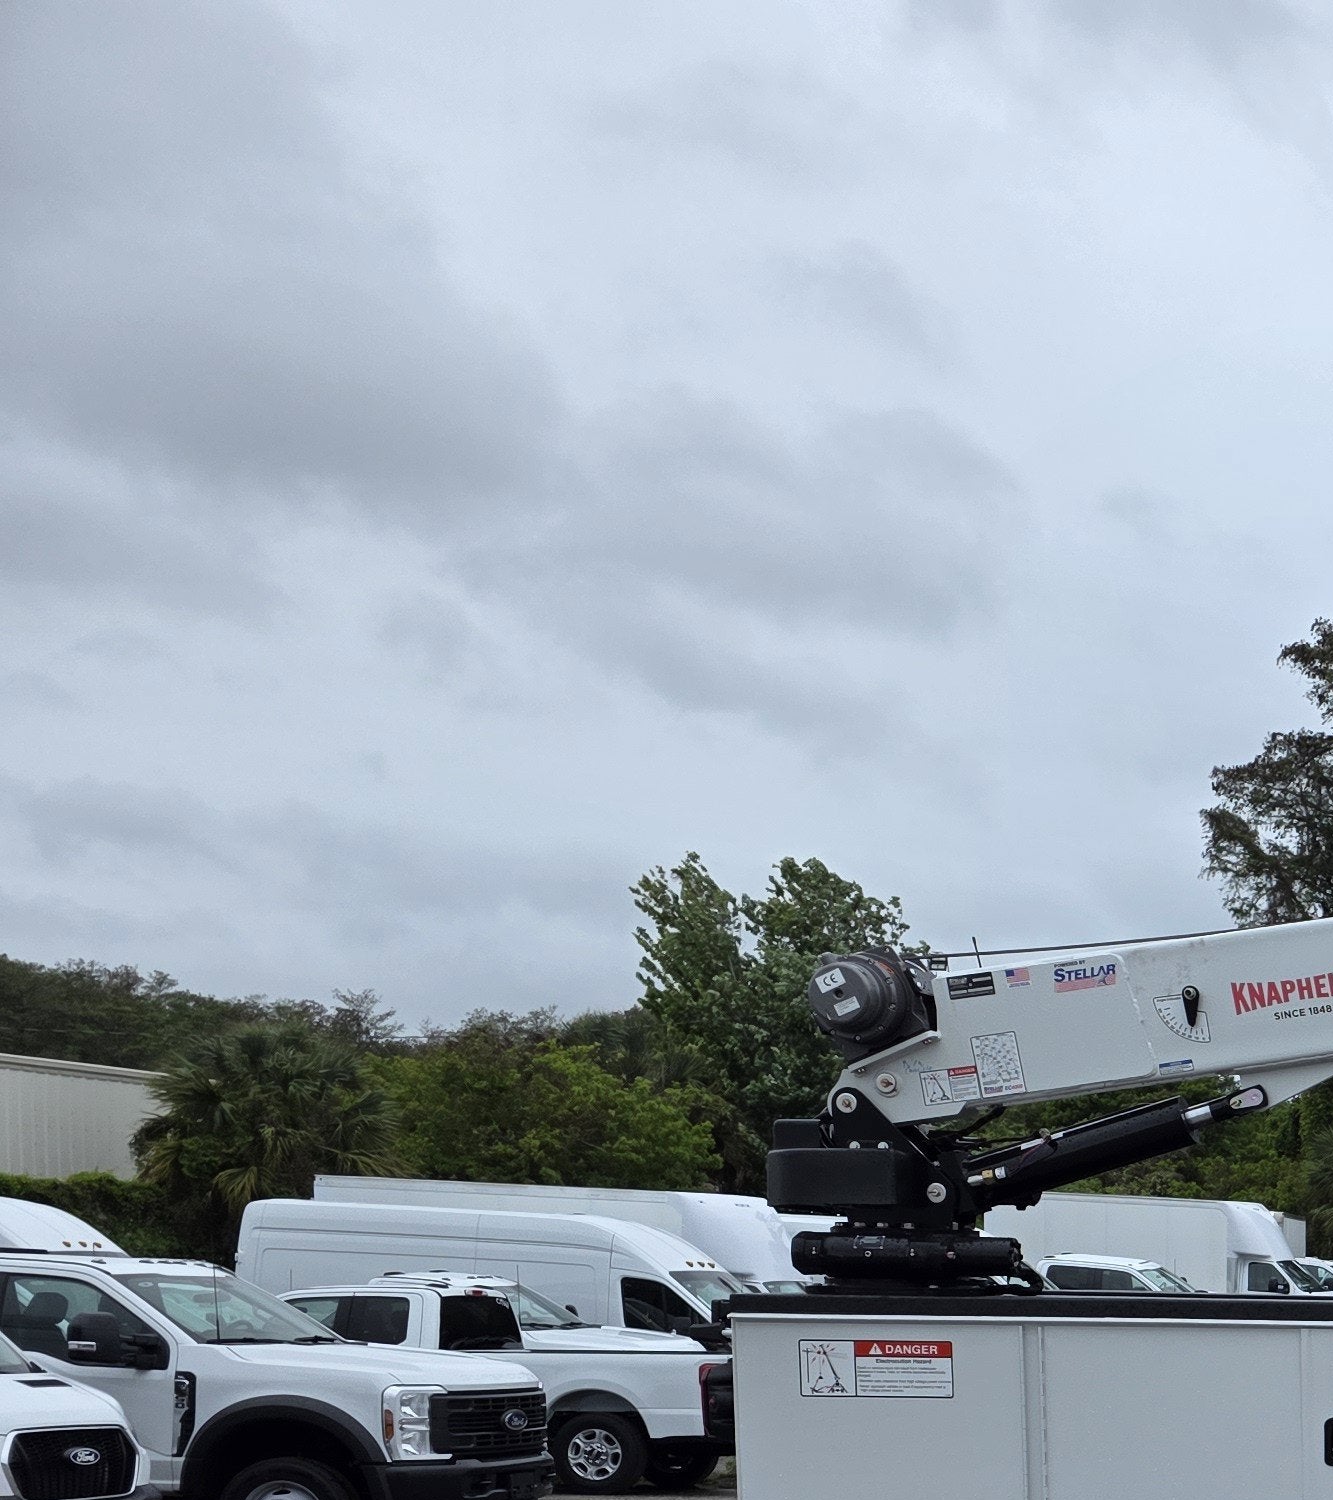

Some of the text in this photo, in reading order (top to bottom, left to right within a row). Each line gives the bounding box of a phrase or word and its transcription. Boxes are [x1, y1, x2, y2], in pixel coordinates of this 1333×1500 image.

[1053, 964, 1116, 983] STELLAR
[1274, 1004, 1333, 1020] SINCE 1848
[885, 1344, 938, 1355] DANGER
